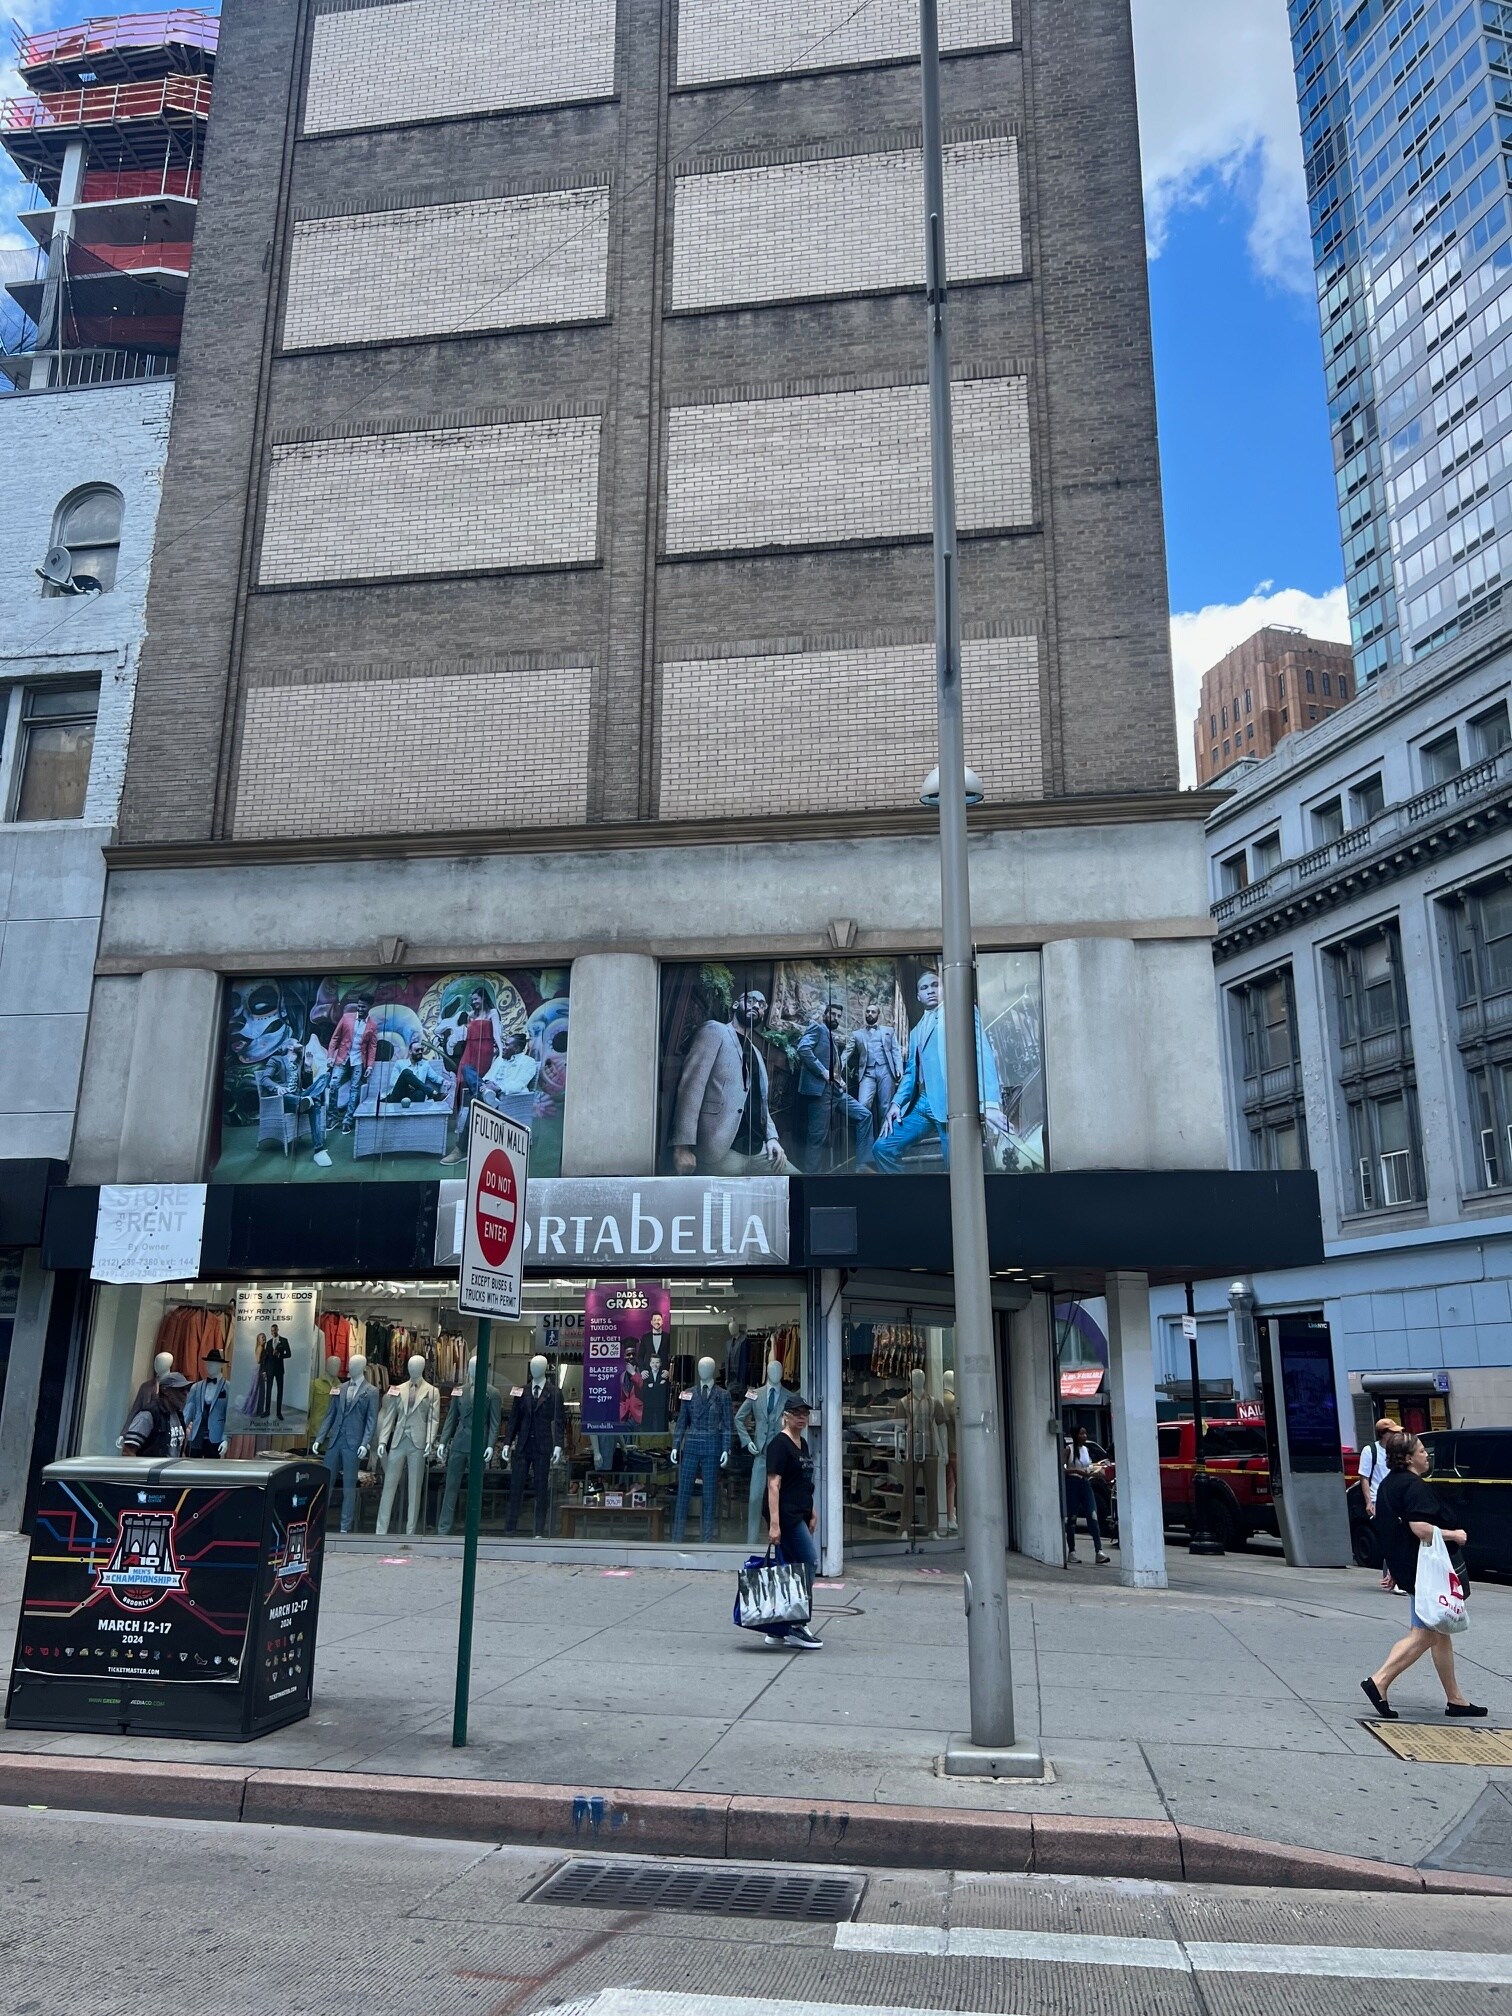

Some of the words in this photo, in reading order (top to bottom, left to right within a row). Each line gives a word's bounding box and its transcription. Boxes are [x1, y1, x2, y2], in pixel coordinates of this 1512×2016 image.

[474, 1113, 504, 1142] FULTON
[506, 1125, 526, 1156] MALL
[486, 1170, 496, 1189] DO
[498, 1174, 512, 1194] NOT
[116, 1186, 190, 1207] STORE
[127, 1211, 187, 1232] RENT
[484, 1221, 507, 1243] ENTER
[128, 1243, 138, 1253] By
[142, 1243, 170, 1251] Owner
[471, 1273, 490, 1288] EXCEPT
[491, 1277, 508, 1292] BUSES
[275, 1292, 313, 1300] TUXEDOS
[465, 1288, 486, 1303] TRUCKS
[487, 1292, 499, 1305] WITH
[500, 1294, 517, 1308] PERMIT
[606, 1299, 648, 1309] GRADS
[589, 1366, 618, 1374] BLAZERS
[589, 1387, 607, 1395] TOPS
[111, 1574, 172, 1585] CHAMPIONSHIP
[122, 1596, 154, 1607] BROOKLYN
[269, 1603, 291, 1620] MARCH
[291, 1599, 309, 1614] 12-17
[98, 1619, 140, 1632] MARCH
[143, 1621, 172, 1634] 12-17
[121, 1635, 144, 1644] 2024
[108, 1666, 160, 1676] TICKETMASTER.COM
